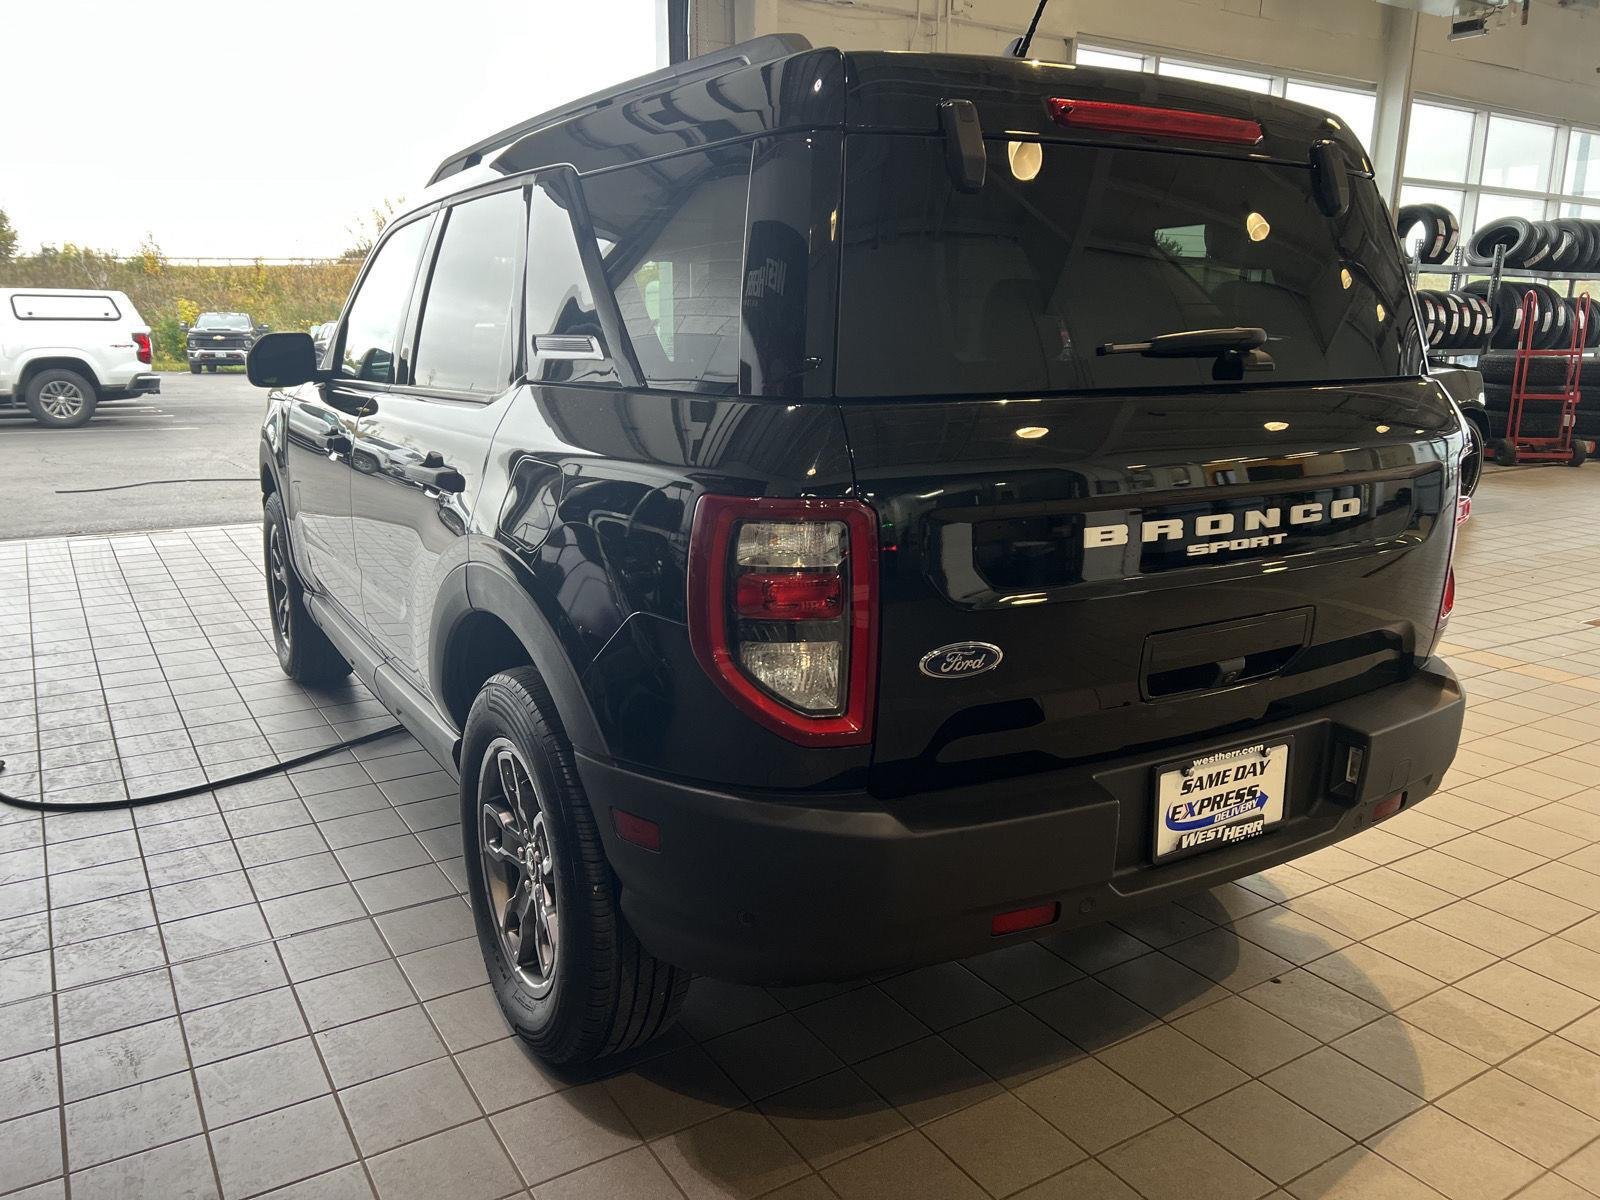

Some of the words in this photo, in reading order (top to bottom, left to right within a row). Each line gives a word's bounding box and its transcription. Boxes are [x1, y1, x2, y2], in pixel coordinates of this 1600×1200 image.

[1083, 497, 1361, 548] BRONCO
[1186, 532, 1288, 556] SPORT
[940, 650, 986, 672] Ford
[1193, 744, 1264, 767] westherr.com
[1180, 768, 1232, 796] SAME
[1233, 759, 1271, 783] DAY
[1171, 784, 1259, 822] EXPRESS
[1214, 798, 1259, 823] DELIVERY
